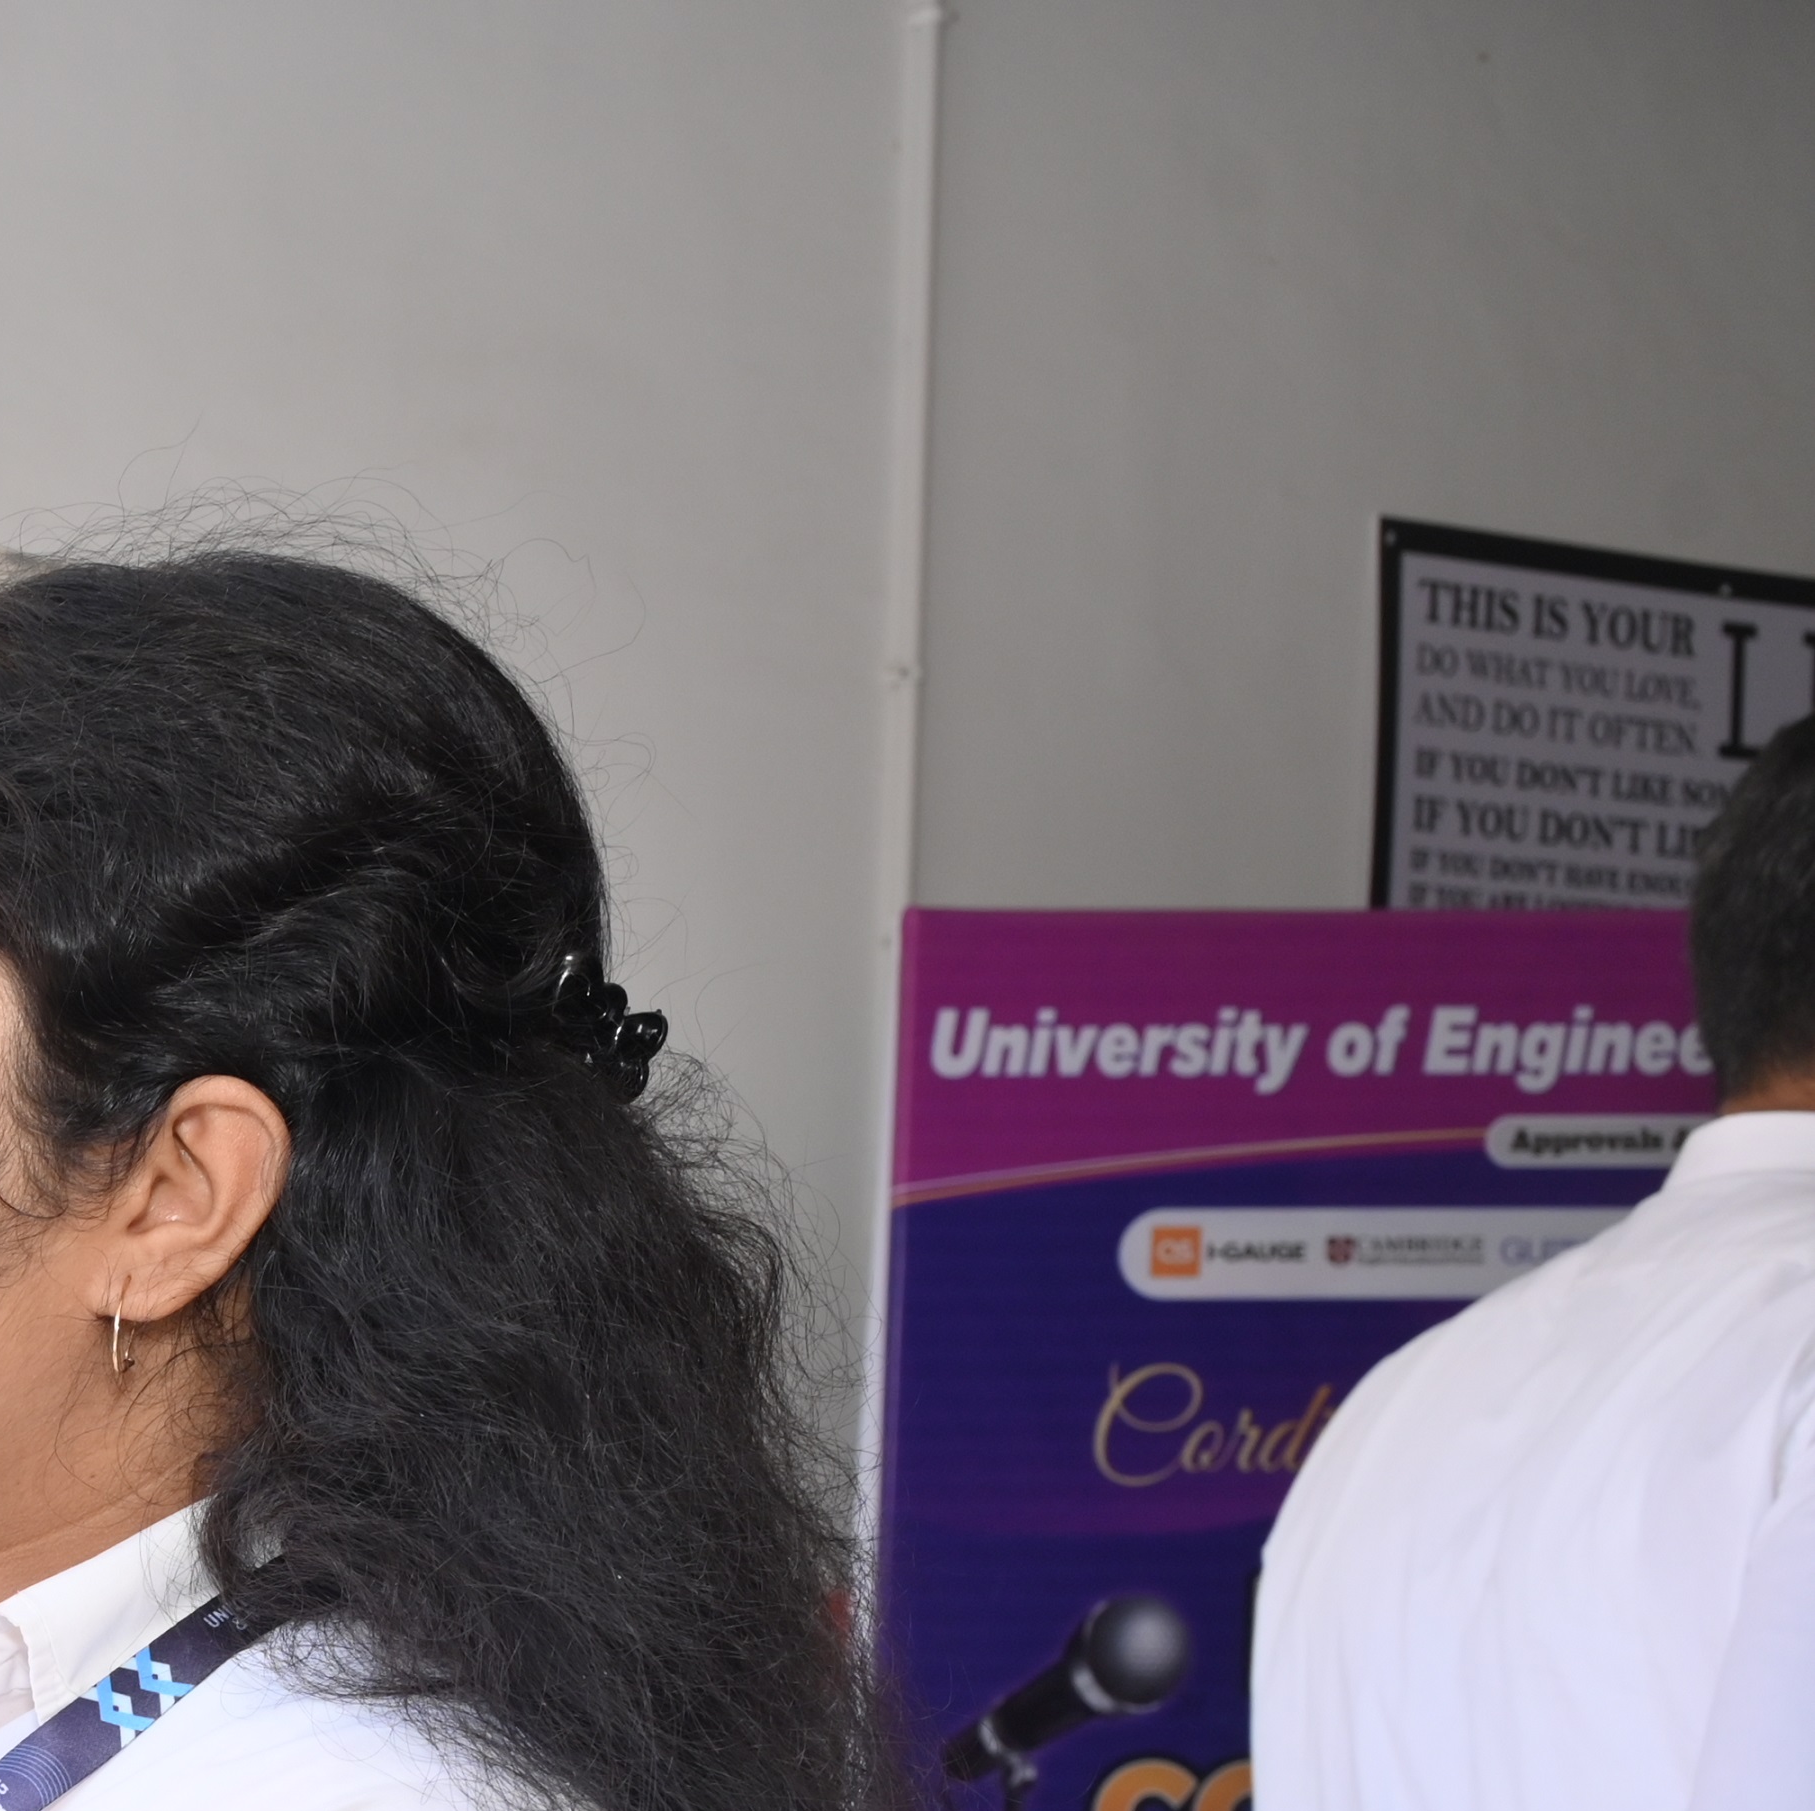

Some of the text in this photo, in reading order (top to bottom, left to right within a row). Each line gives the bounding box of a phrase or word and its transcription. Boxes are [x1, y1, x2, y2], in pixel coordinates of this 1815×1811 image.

[1420, 578, 1520, 634] THIS
[1534, 593, 1569, 640] IS
[1582, 600, 1696, 658] YOUR
[1417, 642, 1459, 678] DO
[1466, 649, 1551, 691] WHAT
[1559, 660, 1619, 698] YOU
[1415, 692, 1483, 732] AND
[1492, 700, 1540, 739] DO
[1548, 707, 1584, 744] IT
[1416, 747, 1444, 777] IF
[1449, 752, 1511, 788] YOU
[1517, 759, 1604, 798] DON'T
[1612, 772, 1672, 806] LIKE
[1413, 793, 1447, 833] IF
[1455, 799, 1531, 842] YOU
[1538, 810, 1647, 855] DON'T
[931, 1003, 1714, 1096] University of Enginee
[1510, 1126, 1664, 1157] Approvals
[1093, 1362, 1334, 1488] Cord
